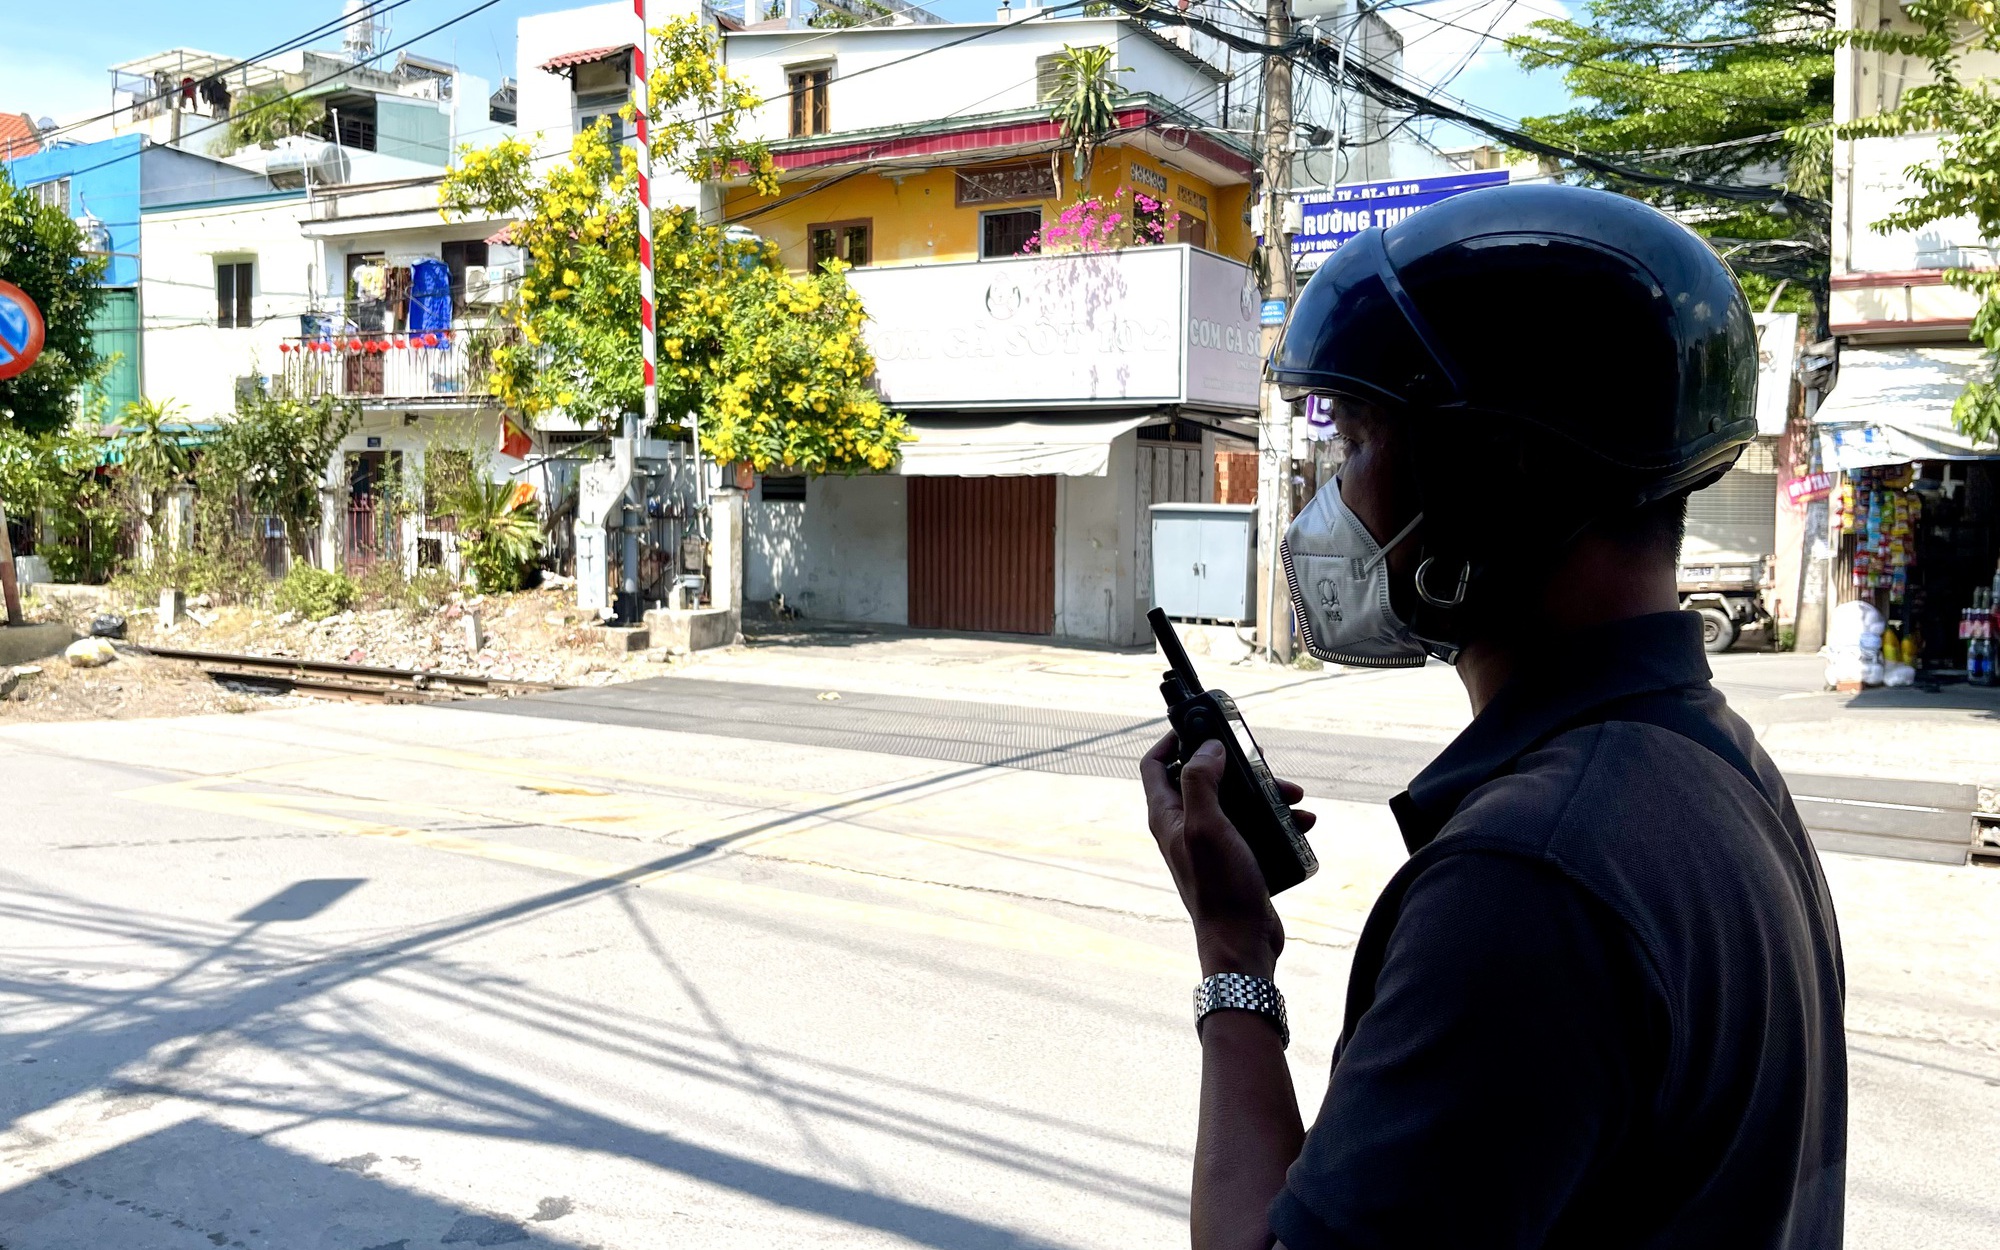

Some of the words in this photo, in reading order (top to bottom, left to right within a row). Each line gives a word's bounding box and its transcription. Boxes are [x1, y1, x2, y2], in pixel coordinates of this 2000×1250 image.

[1303, 208, 1370, 236] RƯỜNG
[1189, 317, 1221, 351] CƠM
[1225, 321, 1244, 355] GÀ
